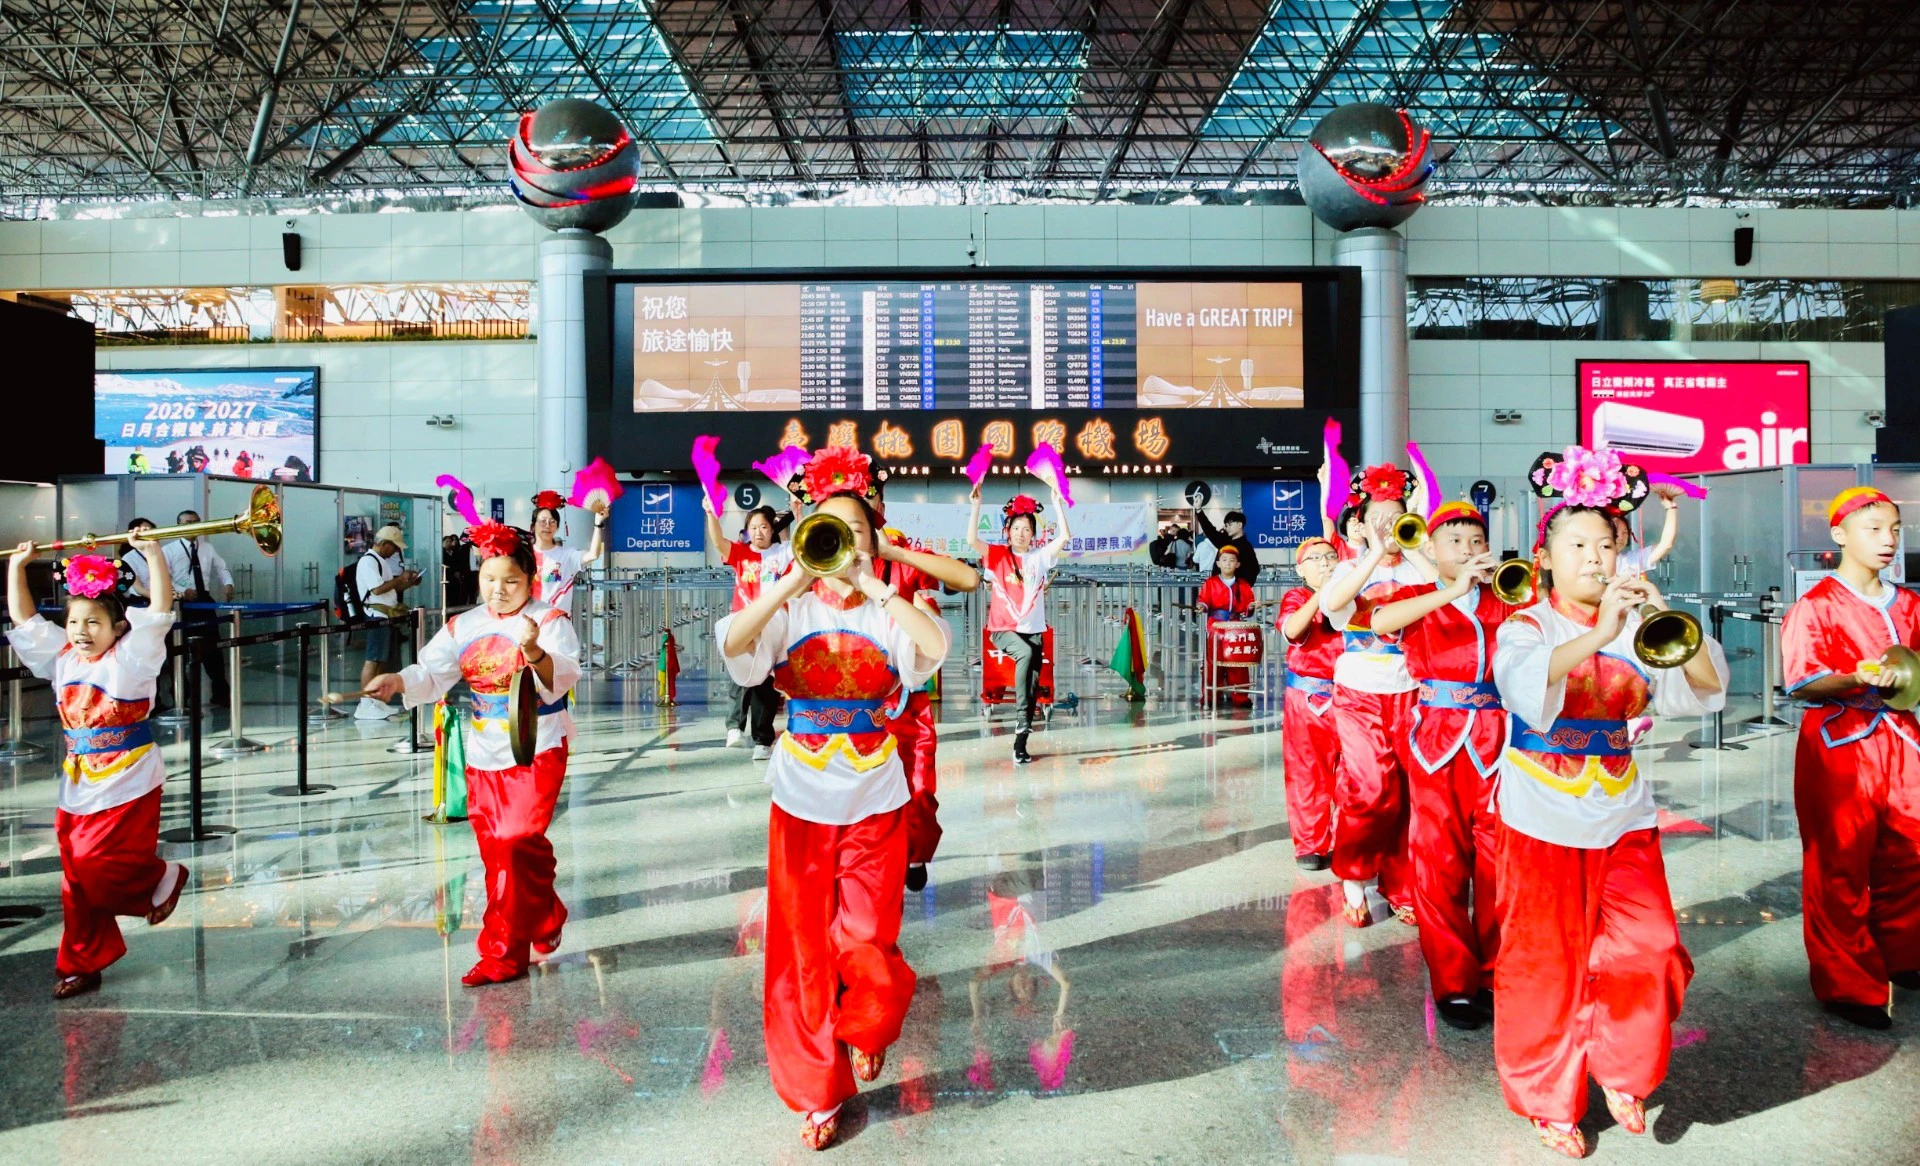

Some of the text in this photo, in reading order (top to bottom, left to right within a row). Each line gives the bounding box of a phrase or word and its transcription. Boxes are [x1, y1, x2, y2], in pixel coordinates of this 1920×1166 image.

[642, 295, 687, 320] 祝您
[1146, 308, 1293, 327] Have a GREAT TRIP!
[641, 328, 733, 352] 旅途愉快
[144, 401, 257, 420] 2026 2027
[1722, 411, 1808, 470] air
[952, 465, 1082, 475] INRNATAL
[1103, 464, 1173, 474] AIRPORT
[742, 488, 753, 506] 5
[640, 518, 675, 536] 出發
[1272, 514, 1307, 532] 出發
[626, 537, 690, 550] Departures
[1258, 533, 1309, 547] Departu
